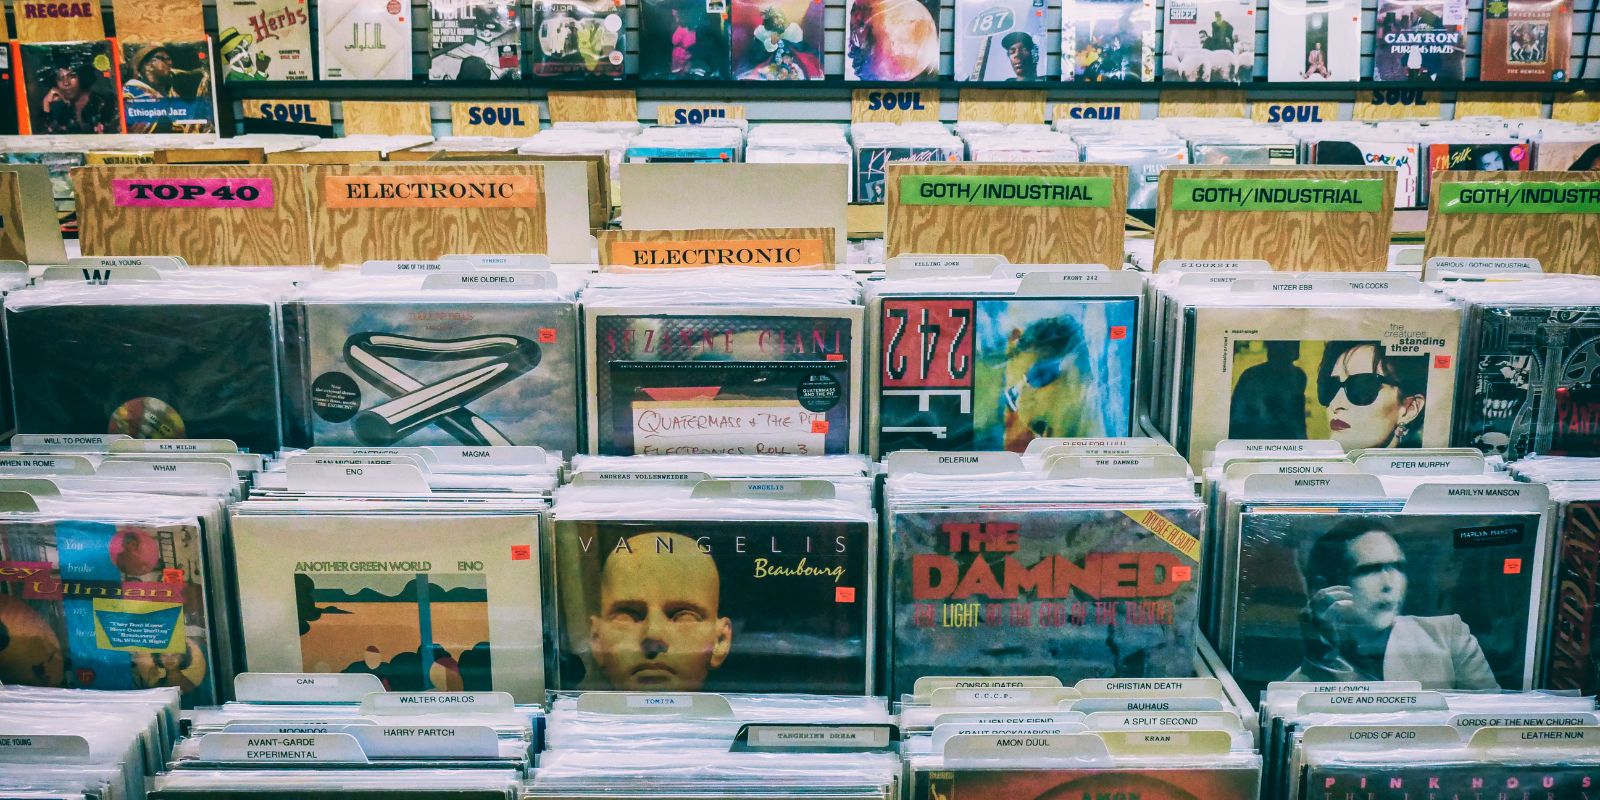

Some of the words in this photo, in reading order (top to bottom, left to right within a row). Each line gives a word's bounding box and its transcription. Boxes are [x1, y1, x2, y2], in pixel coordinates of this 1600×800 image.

[25, 4, 92, 18] REGGAE
[248, 6, 307, 42] Herbs
[972, 12, 1009, 32] 187
[868, 92, 924, 110] SOUL
[128, 108, 167, 118] Ethiopian
[168, 108, 187, 116] Jazz
[260, 104, 316, 122] SOUL
[468, 106, 525, 126] SOUL
[1268, 106, 1322, 123] SOUL
[130, 184, 206, 200] TOP
[212, 184, 259, 200] 40
[346, 182, 514, 199] ELECTRONIC
[920, 183, 1092, 202] GOTH/INDUSTRIAL
[1192, 188, 1362, 206] GOTH/INDUSTRIAL
[633, 248, 800, 265] ELECTRONIC
[82, 269, 110, 285] W
[608, 328, 735, 354] SUZANNE
[758, 328, 842, 354] CIANI
[1384, 330, 1426, 338] creatures
[1399, 336, 1446, 348] standing
[1391, 344, 1420, 353] there
[638, 410, 742, 433] QUATERMASS
[758, 412, 792, 427] THE
[756, 442, 791, 454] ROLL
[798, 444, 808, 454] 3
[942, 522, 1021, 552] THE
[1142, 511, 1169, 540] DOUBLE
[1168, 527, 1197, 553] ALBUM
[66, 538, 83, 550] You
[578, 536, 846, 554] VANGELIS
[68, 562, 94, 573] broke
[295, 562, 349, 572] ANOTHER
[350, 562, 387, 572] GREEN
[389, 562, 432, 572] WORLD
[458, 562, 484, 572] ENO
[754, 558, 845, 582] Beaubourg
[912, 552, 1187, 600] DAMNED
[32, 581, 173, 597] Ullman
[913, 604, 936, 627] THE
[943, 604, 980, 627] LIGHT
[1095, 602, 1119, 625] THE
[1325, 777, 1439, 789] PINK
